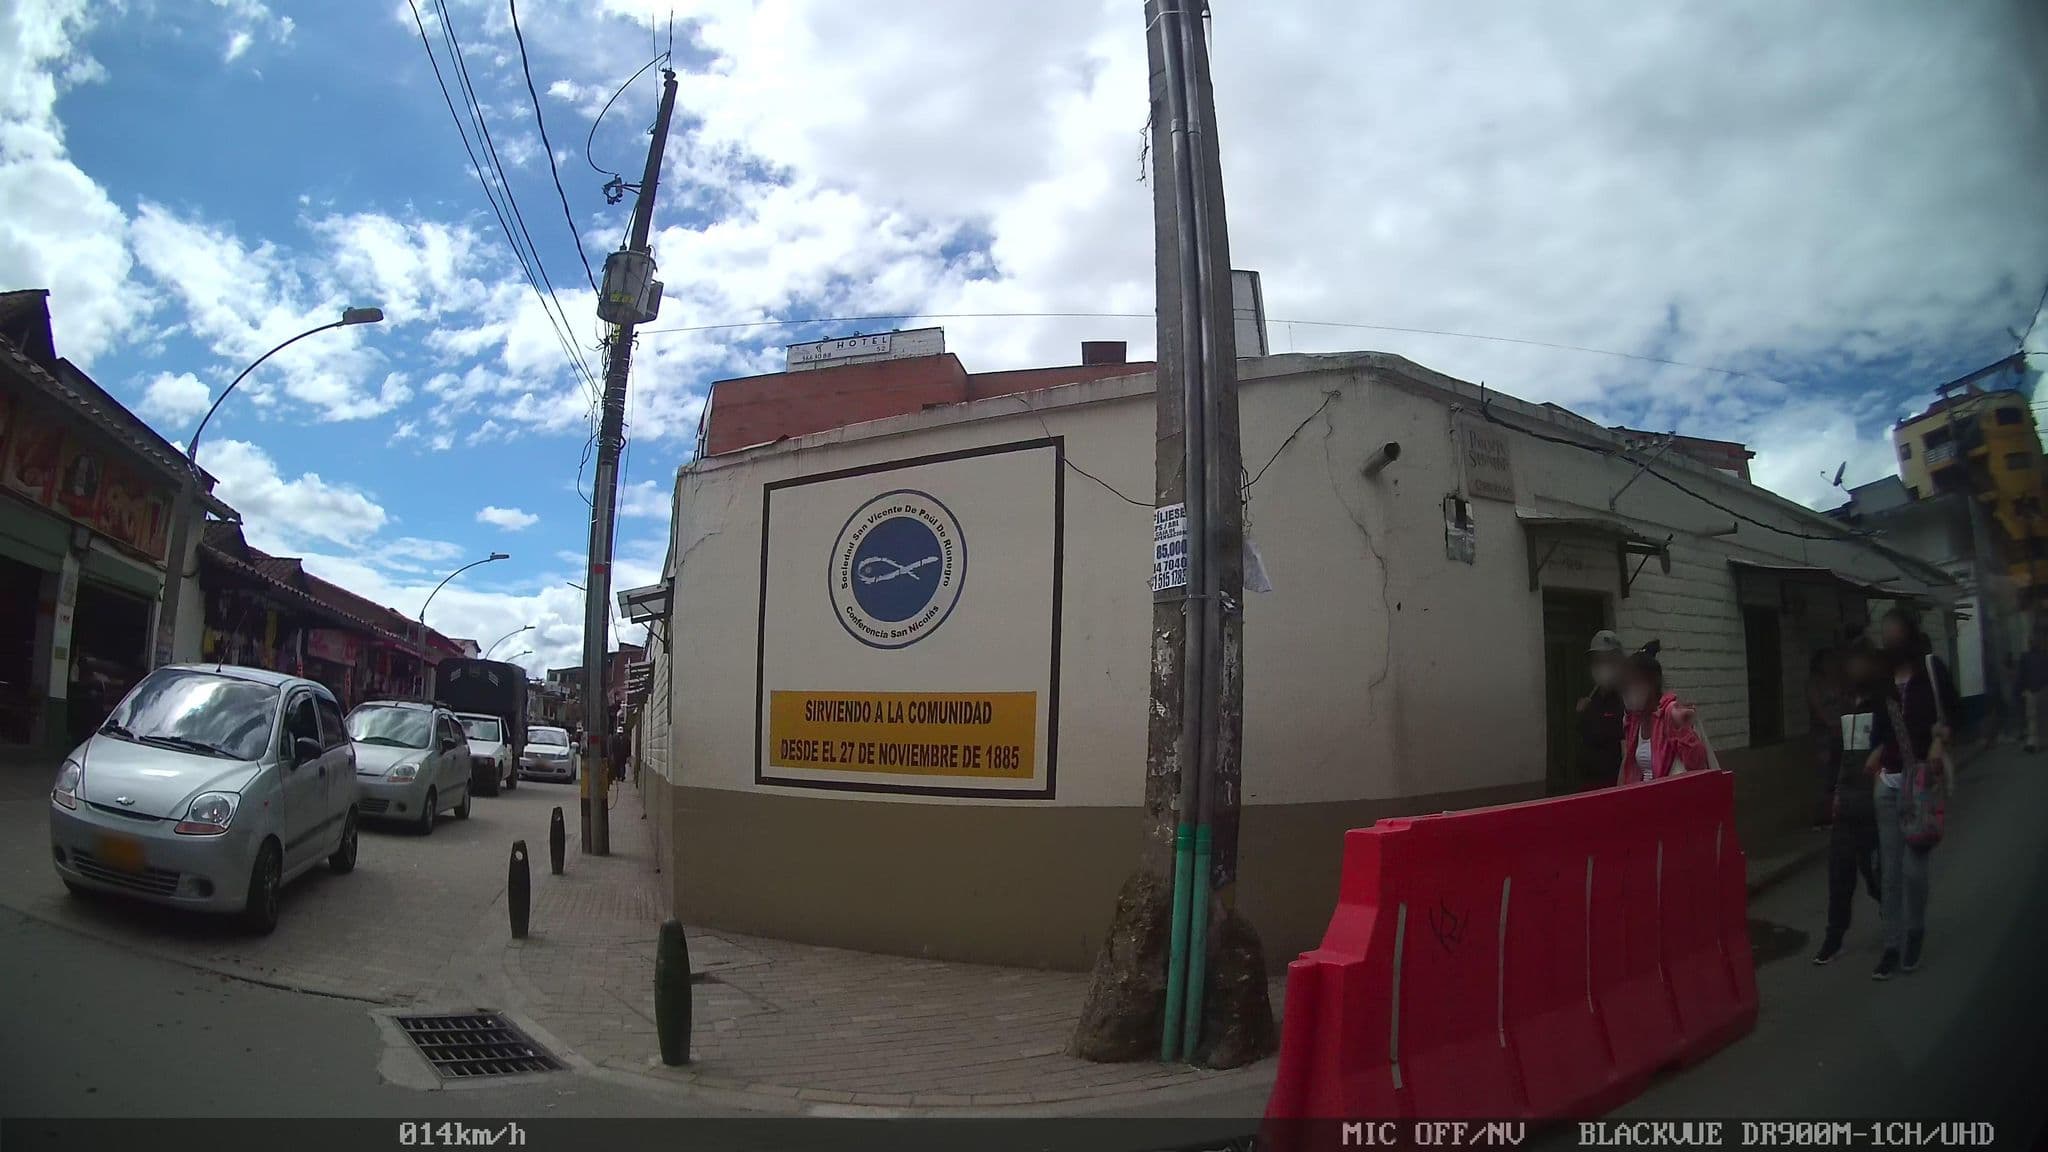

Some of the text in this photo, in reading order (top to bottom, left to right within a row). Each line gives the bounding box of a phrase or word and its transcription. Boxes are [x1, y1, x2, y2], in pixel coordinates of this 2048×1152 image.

[836, 336, 887, 349] HOTEL
[841, 505, 953, 589] Sociedad San Vicente De Paúl De Rionegro
[846, 605, 939, 638] Conferencia San Nicolás
[805, 699, 992, 725] SIRVIENDO A LA COMUNIDAD
[780, 738, 1020, 770] DESDE EL 27 DE NOVIEMBRE DE 1885
